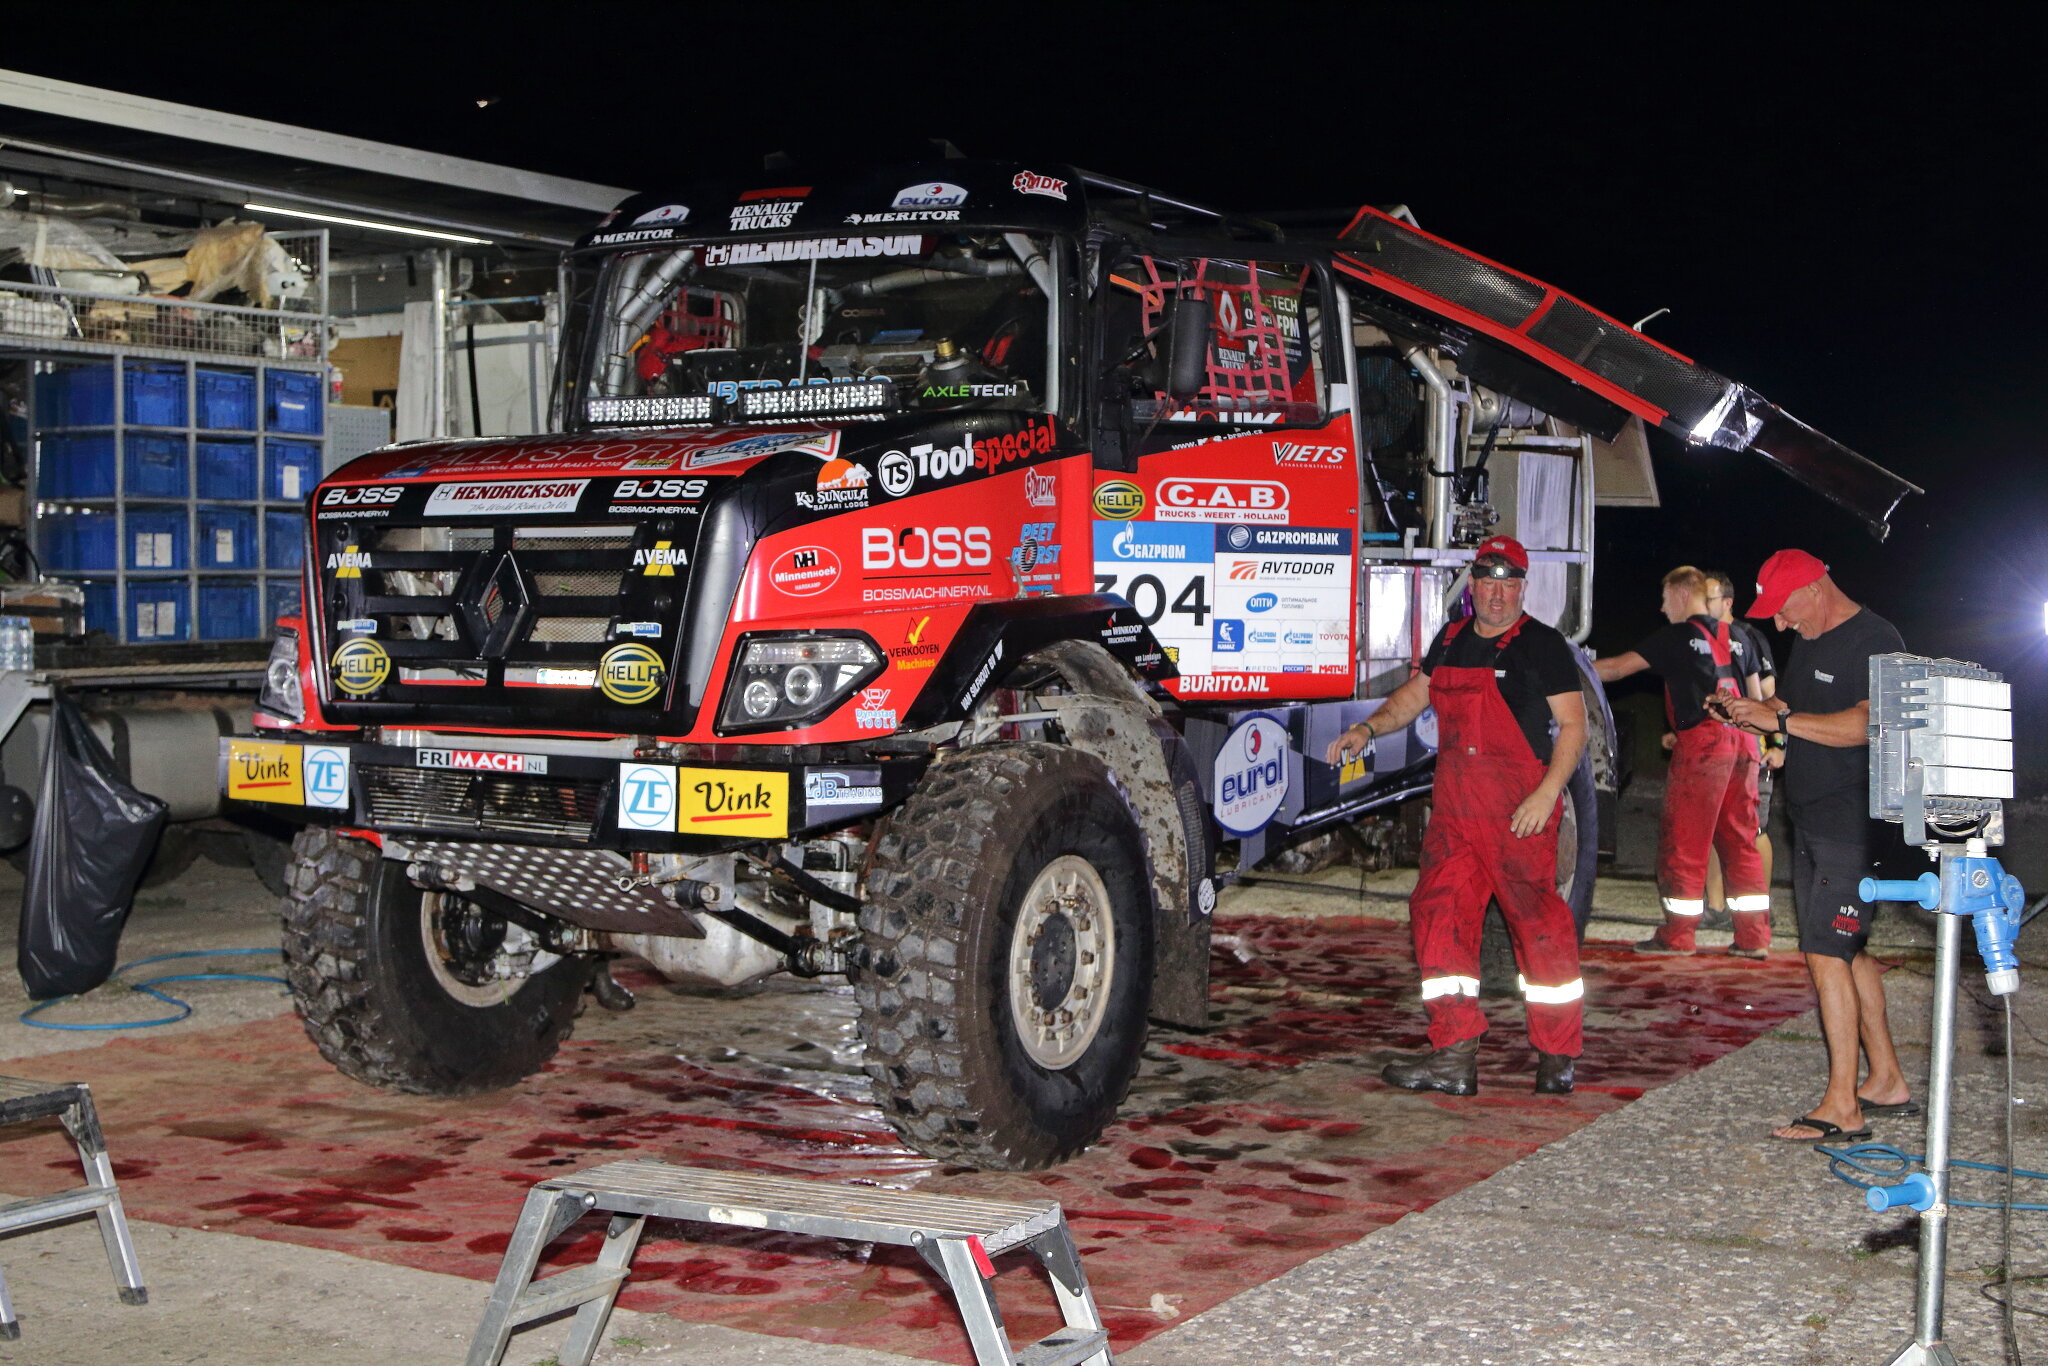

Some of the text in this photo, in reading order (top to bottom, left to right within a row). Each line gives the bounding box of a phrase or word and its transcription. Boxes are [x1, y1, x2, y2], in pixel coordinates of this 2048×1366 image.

[899, 193, 961, 206] eurol
[729, 201, 804, 218] RENAULT
[862, 210, 961, 224] MERITOR
[729, 214, 793, 232] TRUCKS
[600, 228, 674, 244] MERITOR
[922, 383, 1018, 399] AXLETECH
[1271, 441, 1348, 466] VIETS
[883, 461, 909, 486] TS
[322, 486, 405, 506] BOSS
[452, 482, 584, 500] HENDRICKSON
[613, 479, 709, 498] BOSS
[1167, 483, 1276, 508] C.A.B
[813, 500, 870, 512] SAFARI LODGE
[1097, 493, 1143, 508] HELLA
[607, 505, 700, 515] BOSSMACHINERY.NL
[1159, 509, 1197, 519] TRUCKS
[1204, 510, 1236, 520] WEERT
[1243, 511, 1287, 521] HOLLAND
[1020, 522, 1056, 542] PEET
[1256, 530, 1340, 546] GAZPROMBANK
[862, 526, 992, 570] BOSS
[1133, 543, 1186, 560] GAZPROM
[326, 552, 373, 569] AVEMA
[632, 548, 688, 566] AVEMA
[1260, 561, 1336, 576] AVTODOR
[862, 584, 993, 602] BOSSMACHINERY.NL
[1250, 596, 1274, 608] ОПТИ
[1112, 624, 1143, 636] WINKOOP
[1319, 633, 1349, 641] TOYOTA
[888, 643, 940, 659] VERKOOYEN
[339, 657, 387, 673] HELLA
[896, 657, 936, 671] Machines
[1178, 675, 1270, 693] BURITO.NL
[856, 718, 897, 729] TOOLS
[239, 753, 290, 781] Vink
[418, 750, 546, 773] FRIMACH.NL
[308, 760, 344, 793] ZF
[1221, 746, 1283, 805] eurol
[626, 779, 671, 815] ZF
[694, 781, 772, 814] Vink
[1220, 786, 1285, 819] LUBRICANTS
